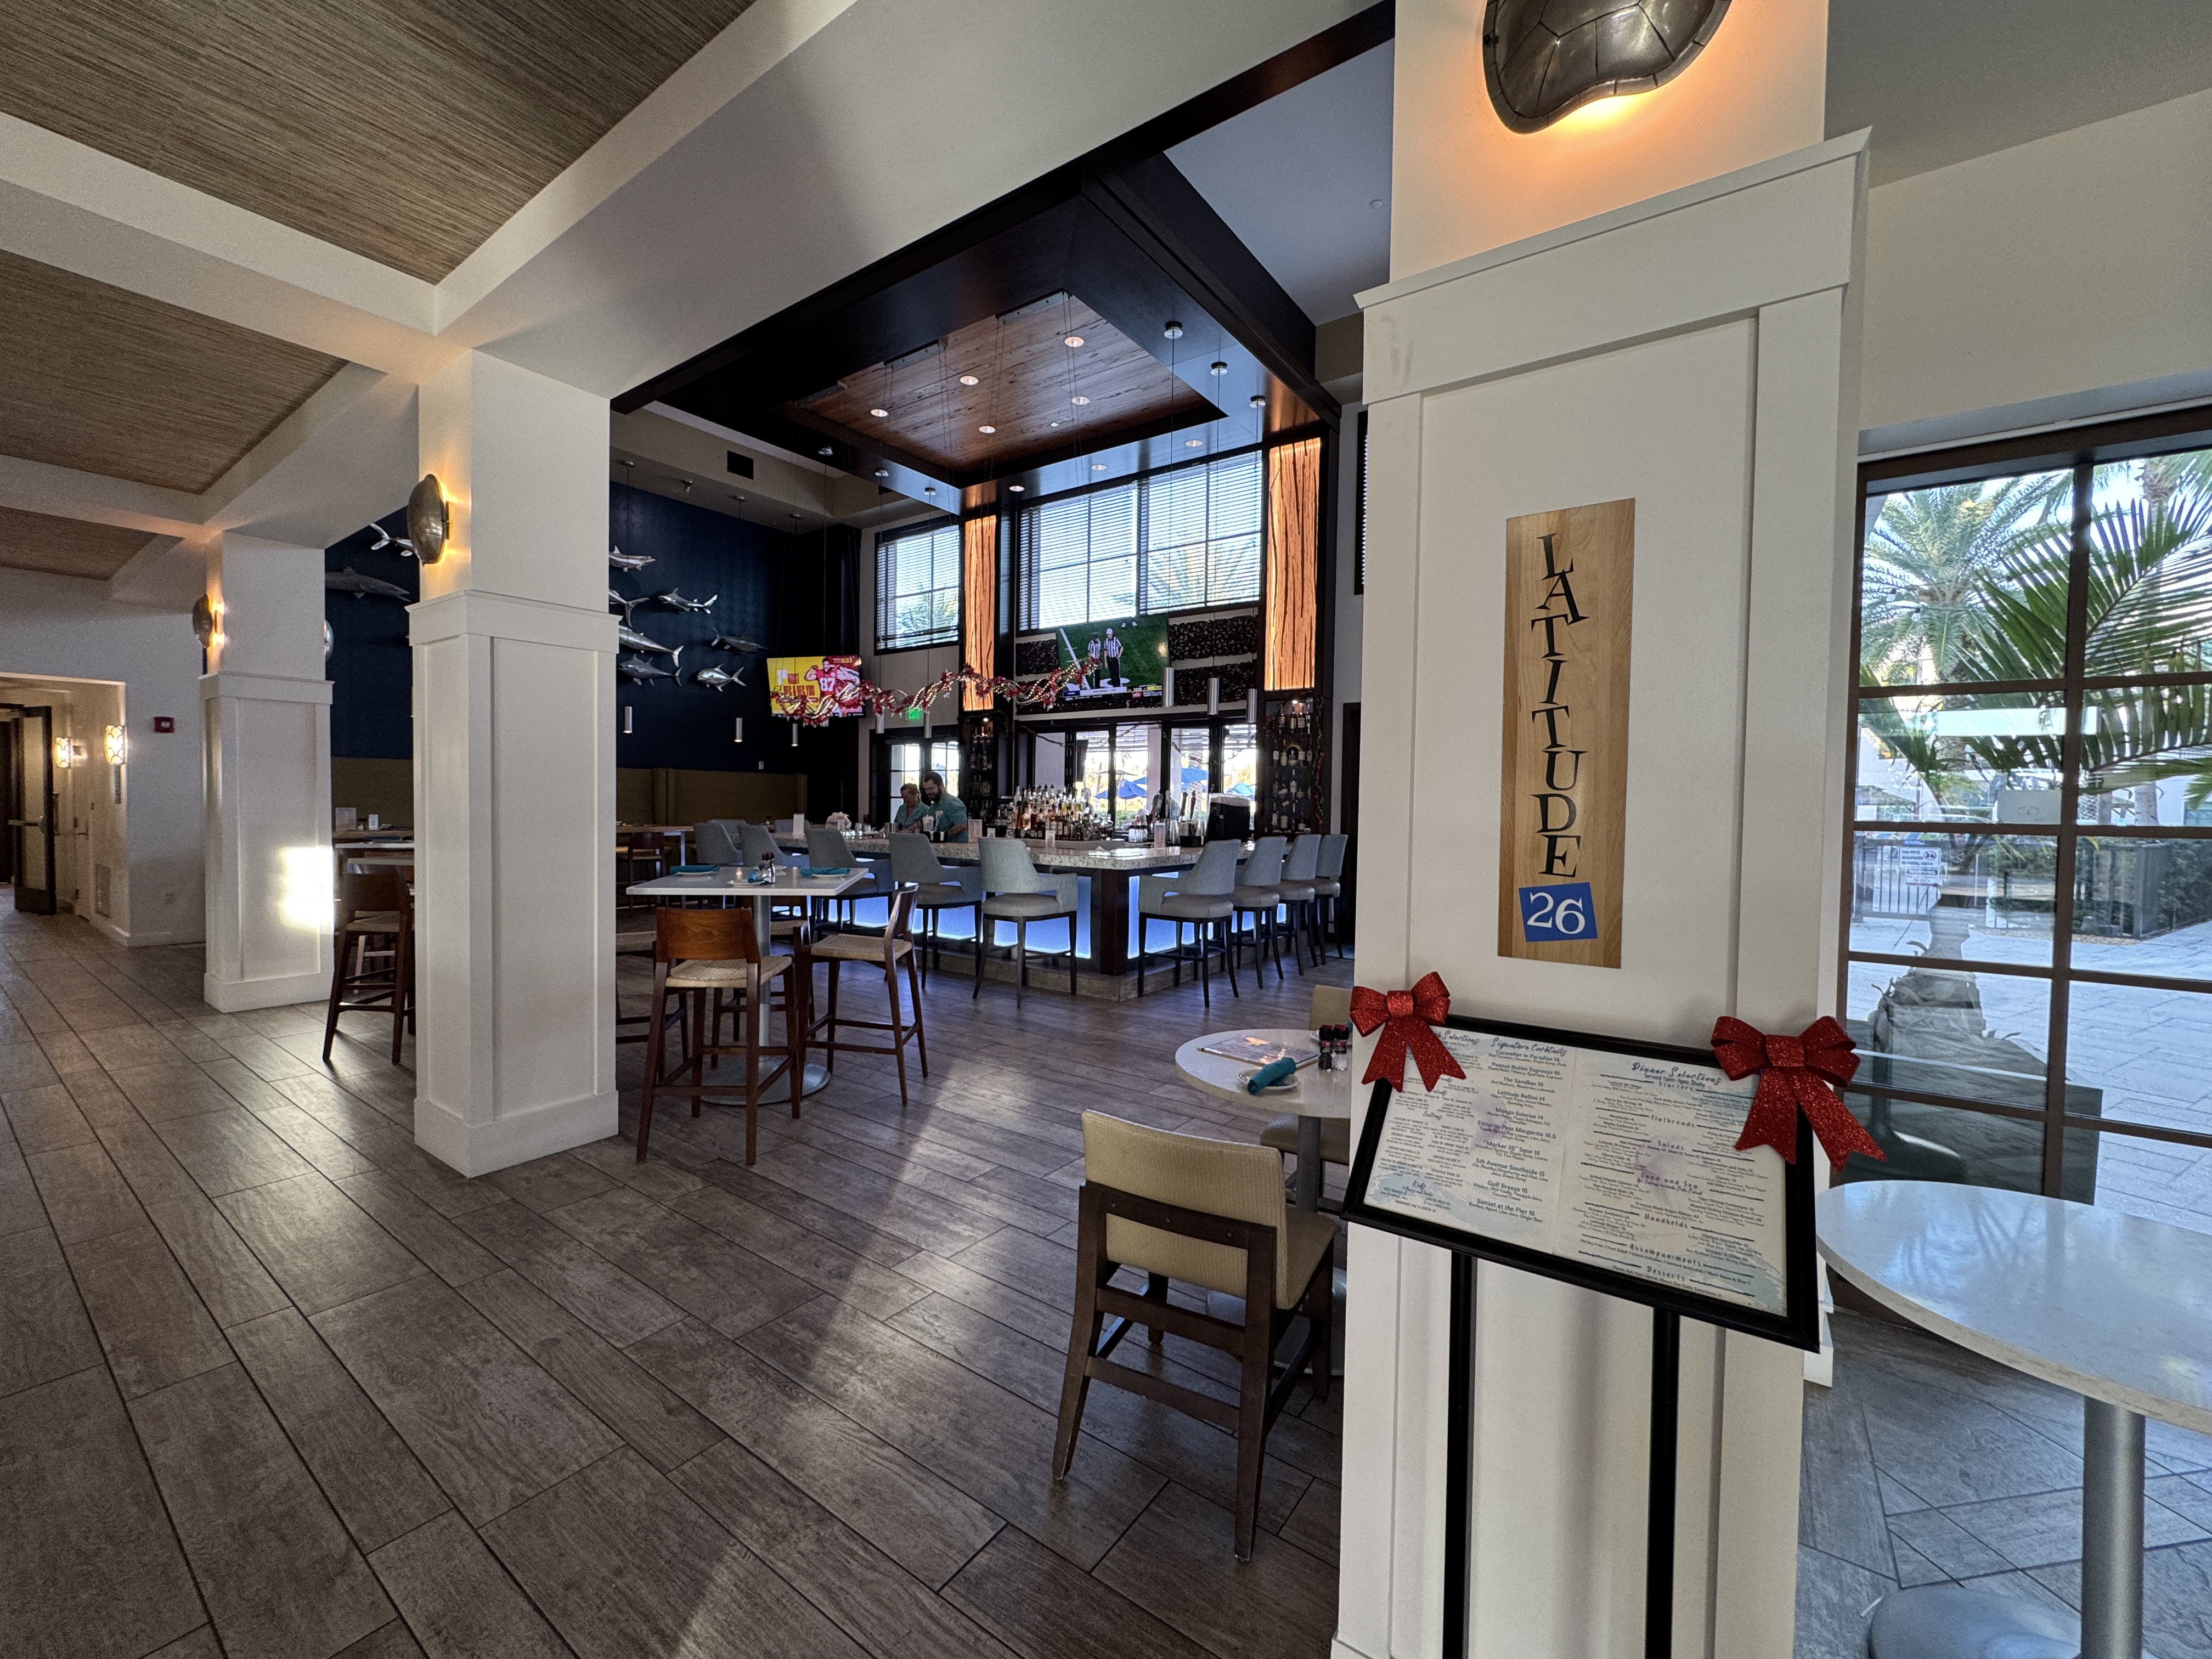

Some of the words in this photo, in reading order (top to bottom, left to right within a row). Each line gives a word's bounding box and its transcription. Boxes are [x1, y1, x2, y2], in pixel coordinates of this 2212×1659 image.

[819, 678, 835, 692] 87
[1531, 532, 1589, 877] LATITUDE
[1527, 891, 1585, 935] 26
[1443, 1030, 1480, 1045] Selections
[1491, 1037, 1530, 1050] Signature
[1531, 1044, 1567, 1057] Cocktails
[1632, 1062, 1666, 1074] Dinner
[1669, 1066, 1722, 1085] Selections
[1659, 1081, 1693, 1091] Starters
[1691, 1080, 1705, 1088] Daily
[1477, 1120, 1500, 1129] Stingray
[1515, 1127, 1543, 1136] Margarita
[1658, 1139, 1684, 1150] Salads
[1486, 1160, 1508, 1169] Avenue
[1509, 1165, 1538, 1175] Southside
[1501, 1183, 1520, 1191] Breeze
[1641, 1172, 1660, 1181] Land
[1684, 1181, 1697, 1189] Sea
[1477, 1198, 1496, 1207] Sunset
[1645, 1213, 1688, 1228] Handhelds
[1630, 1243, 1701, 1267] Accompaniments
[1647, 1266, 1685, 1282] Desserts
